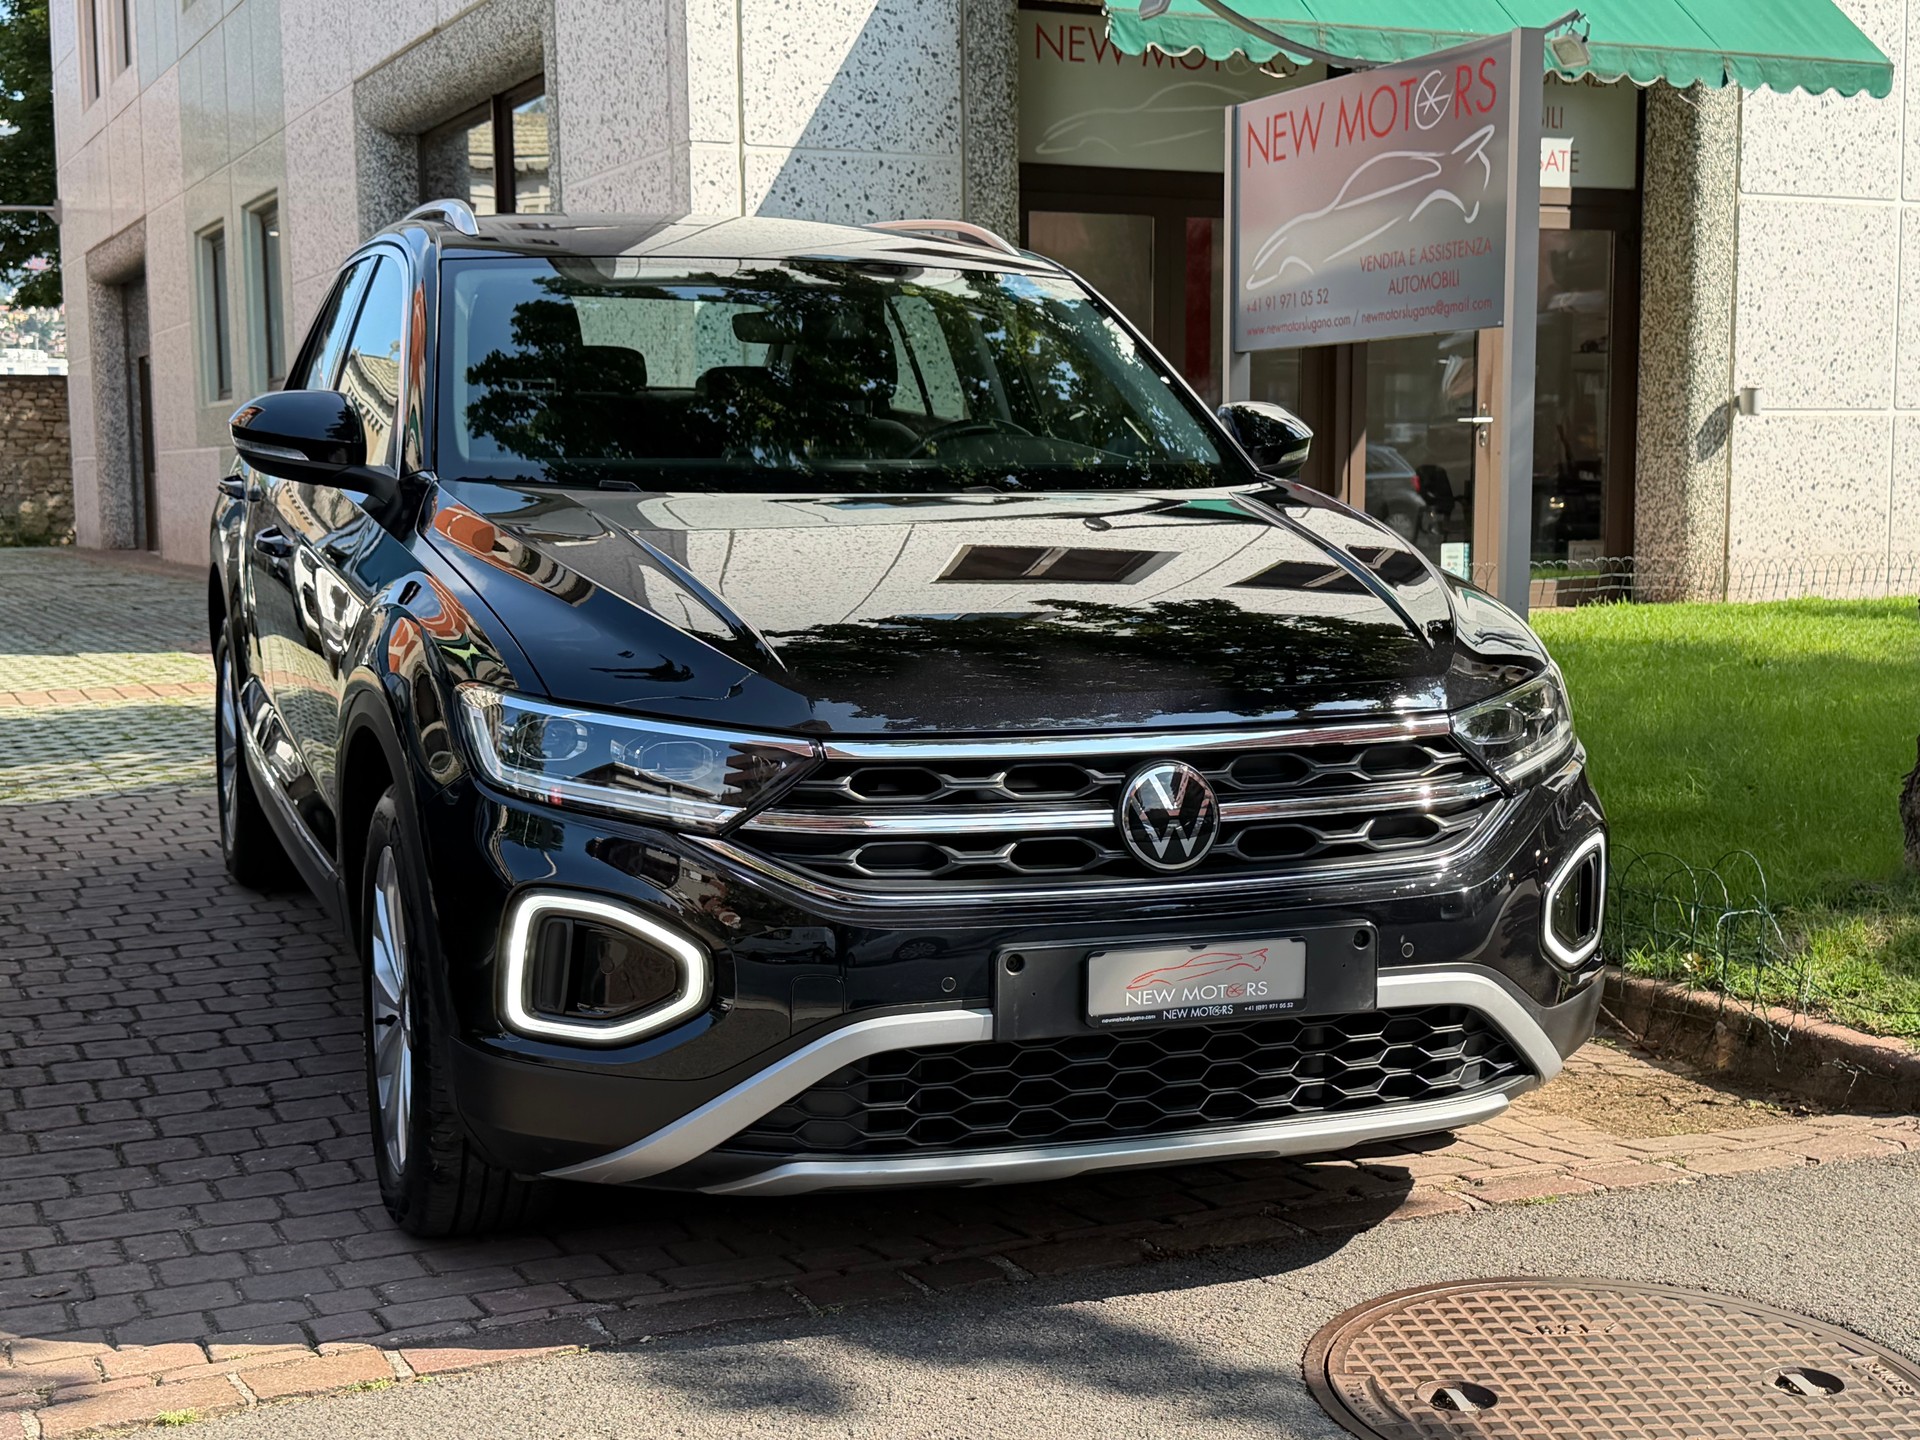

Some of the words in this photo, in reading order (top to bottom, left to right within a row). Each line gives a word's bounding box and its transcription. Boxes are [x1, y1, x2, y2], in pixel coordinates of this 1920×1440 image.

[1247, 102, 1325, 168] NEW
[1335, 57, 1497, 147] MOTORS
[1360, 250, 1406, 273] VENDITA
[1409, 248, 1417, 266] E
[1420, 237, 1493, 264] ASSISTENZA
[1388, 269, 1460, 295] AUTOMOBILI
[1247, 298, 1261, 313] +41
[1265, 295, 1276, 311] 91
[1280, 293, 1297, 309] 971
[1301, 290, 1313, 306] 05
[1317, 288, 1329, 304] 52
[1125, 987, 1176, 1006] NEW
[1182, 981, 1268, 1001] MOTORS
[1163, 1008, 1189, 1020] NEW
[1190, 1004, 1233, 1018] MOTORS
